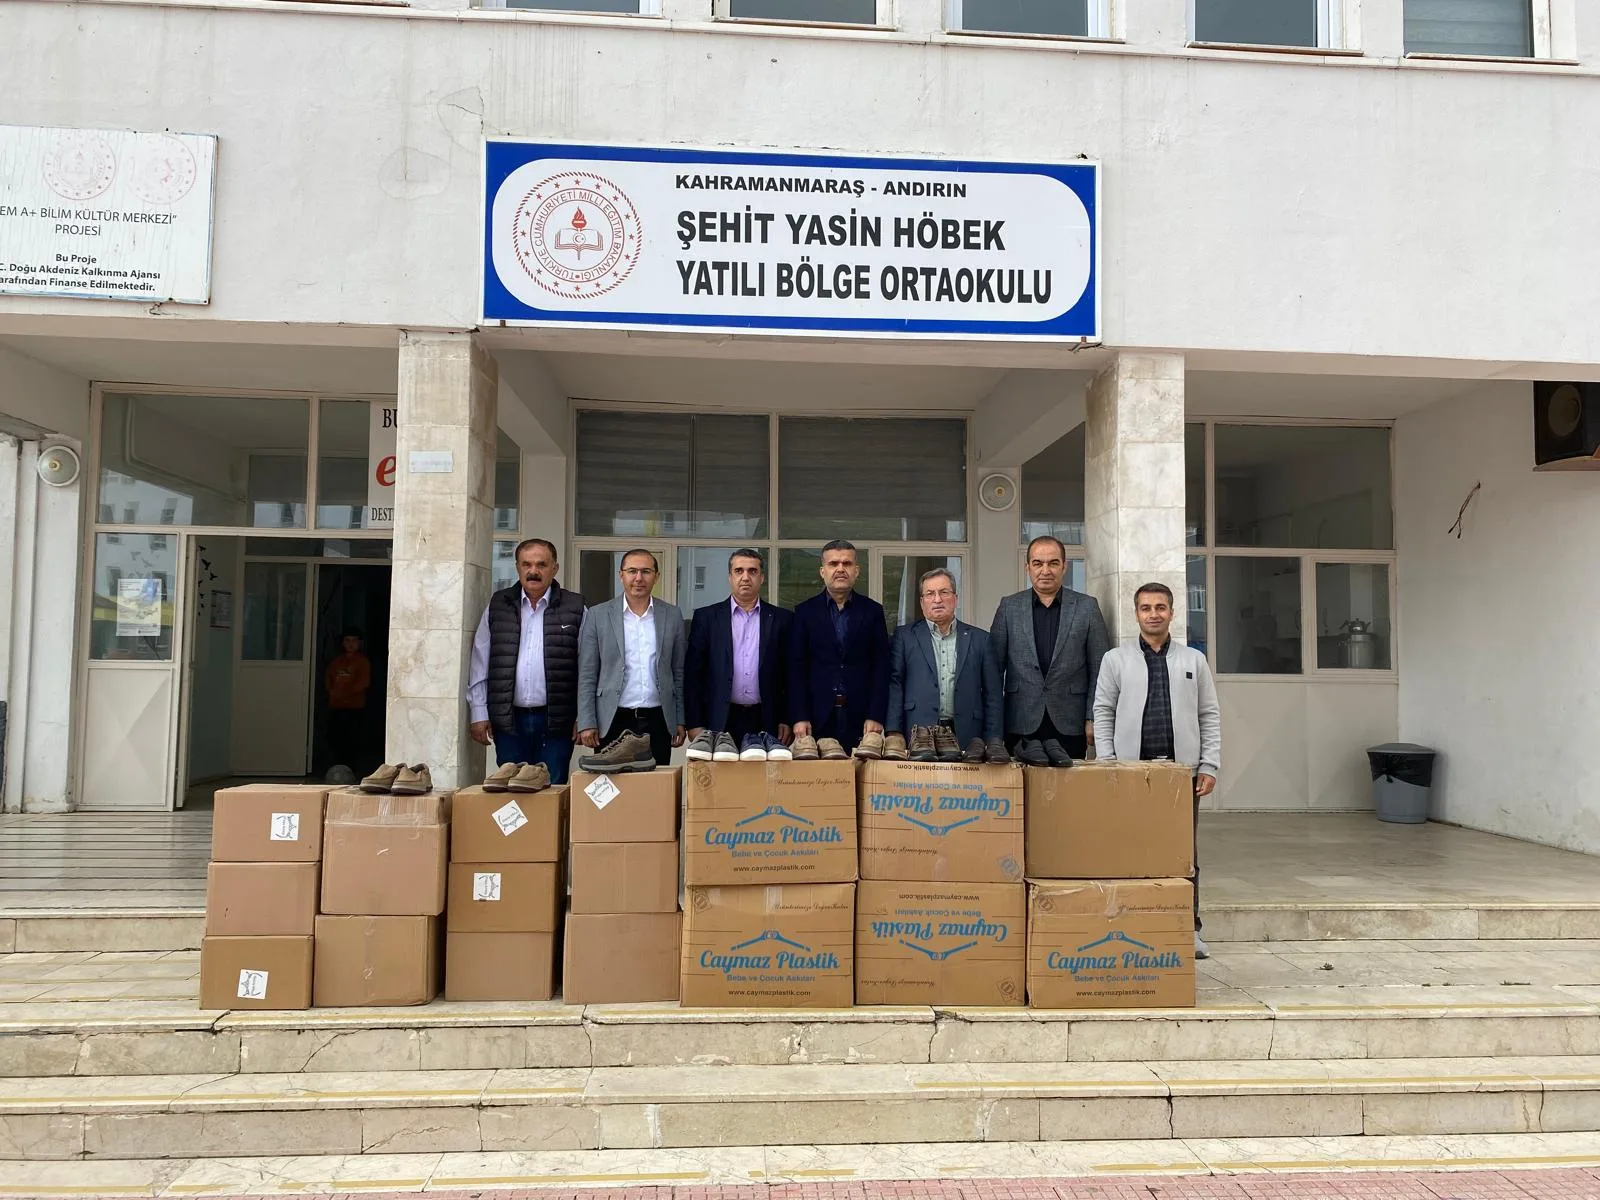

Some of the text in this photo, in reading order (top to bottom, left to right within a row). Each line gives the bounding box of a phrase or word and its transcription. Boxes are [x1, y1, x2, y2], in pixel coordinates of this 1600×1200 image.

[676, 174, 865, 198] KAHRAMANMARAŞ
[883, 181, 966, 198] ANDIRIN
[579, 191, 605, 207] MİLLİ
[20, 206, 38, 217] A+
[40, 206, 72, 220] BİLİM
[75, 208, 120, 222] KÜLTÜR
[534, 191, 576, 247] CUMHURİYETİ
[55, 223, 101, 237] PROJESİ
[676, 205, 1006, 251] ŞEHİT YASİN HÖBEK
[55, 253, 97, 265] Bu Proje
[538, 248, 575, 280] TÜRKİYE
[9, 263, 37, 275] Doğu
[39, 264, 80, 275] Akdeniz
[81, 267, 128, 278] Kalkınma
[130, 269, 161, 280] Ajansı
[676, 256, 1052, 304] YATILI BÖLGE ORTAOKULU
[49, 277, 88, 288] Finanse
[89, 280, 156, 292] Edilmektedir.
[371, 507, 395, 521] DEST
[896, 764, 980, 772] www.caymazplastik.com
[869, 793, 1010, 817] Caymaz Plastik
[705, 826, 843, 850] Caymaz Plastik
[733, 864, 815, 872] www.caymazplastik.com
[871, 918, 1008, 942] Caymaz Plastik
[700, 950, 840, 973] Caymaz Plastik
[1048, 951, 1184, 974] Caymaz Plastik
[728, 989, 811, 997] www.caymazplastik.com
[1076, 989, 1156, 997] www.caymazplastik.com
